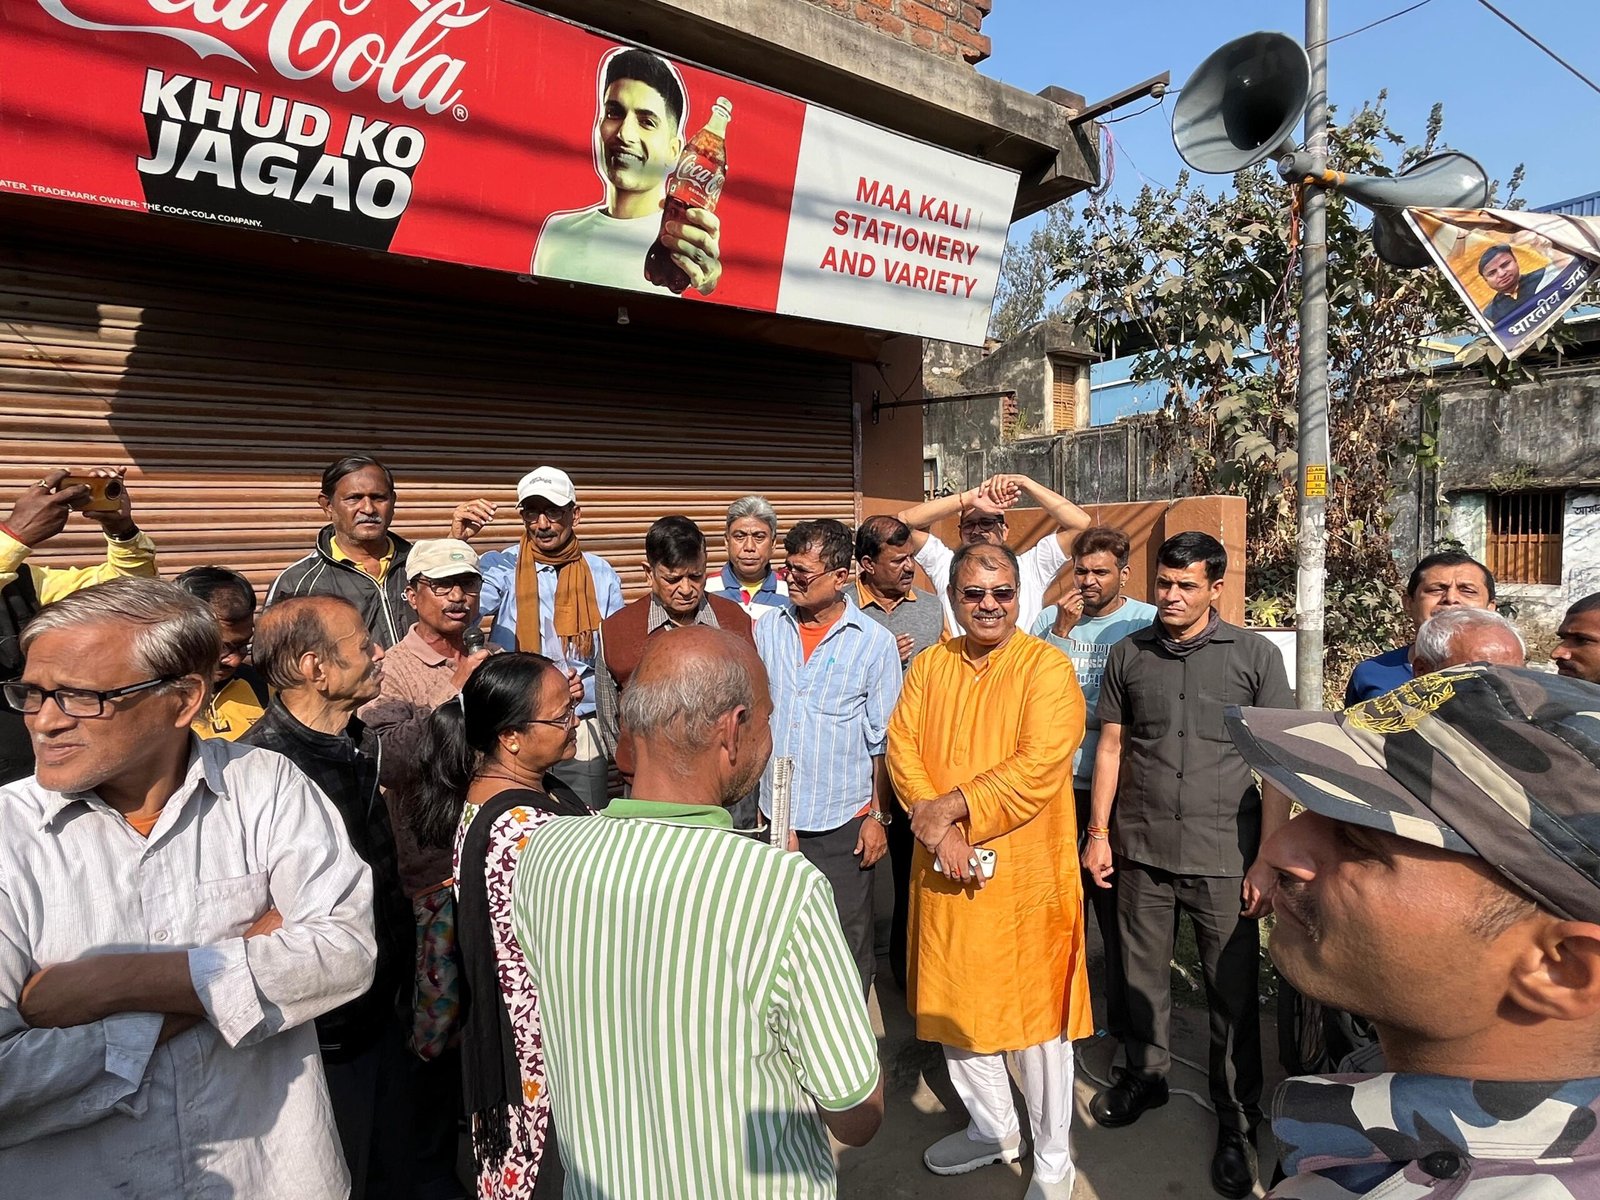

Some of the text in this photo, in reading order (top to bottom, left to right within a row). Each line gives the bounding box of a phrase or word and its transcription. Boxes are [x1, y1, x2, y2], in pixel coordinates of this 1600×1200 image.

[140, 69, 425, 169] KHUD KO
[137, 120, 413, 220] JAGAO
[31, 184, 98, 202] TRADEMARK
[142, 201, 161, 212] THE
[162, 204, 217, 221] COCA-COLA
[217, 213, 263, 228] COMPANY.
[856, 176, 971, 230] MAA KALI
[832, 210, 980, 266] STATIONERY
[819, 246, 978, 298] AND VARIETY
[1508, 290, 1560, 337] भारतीय
